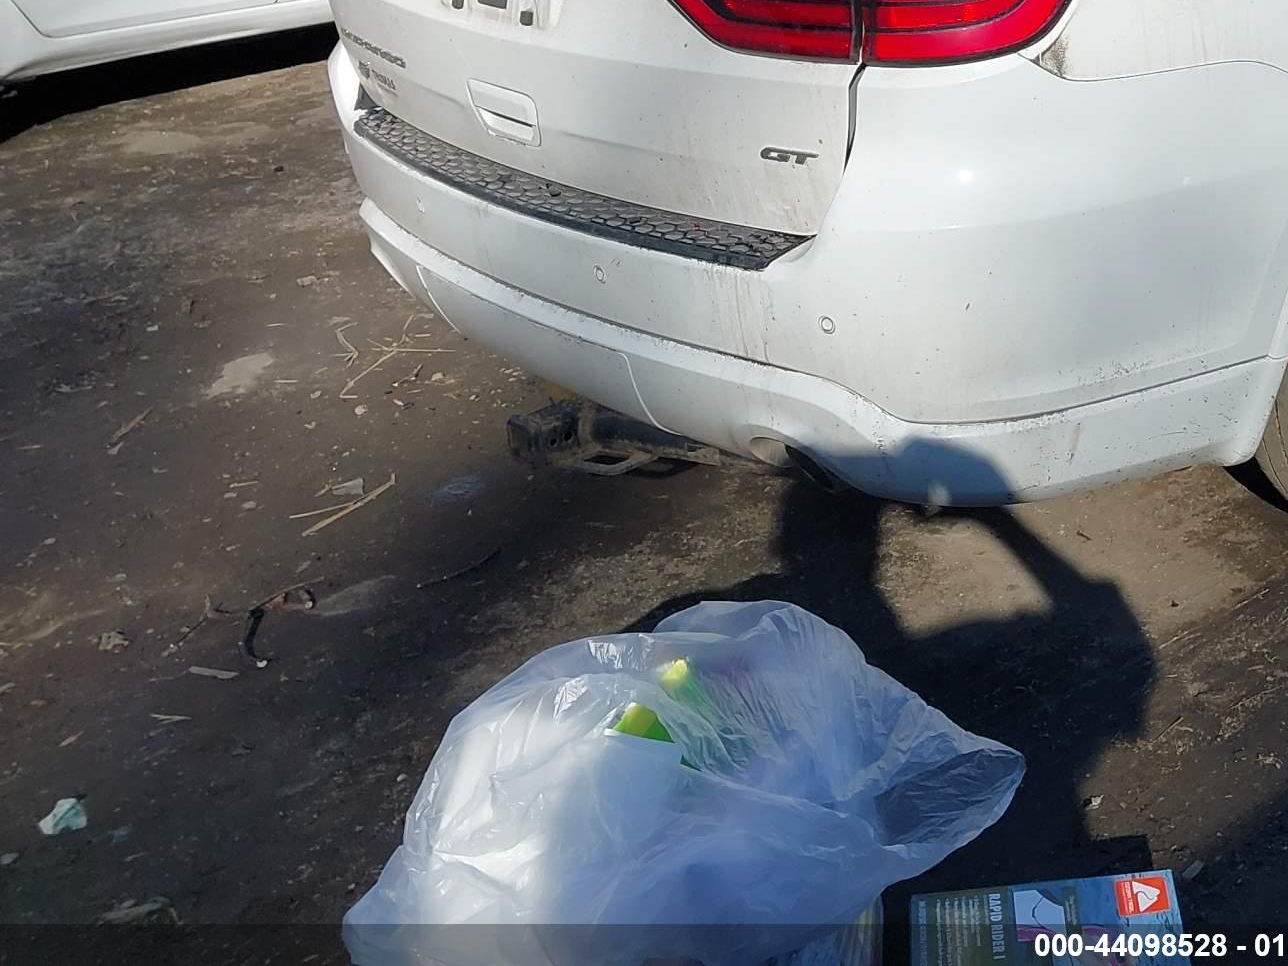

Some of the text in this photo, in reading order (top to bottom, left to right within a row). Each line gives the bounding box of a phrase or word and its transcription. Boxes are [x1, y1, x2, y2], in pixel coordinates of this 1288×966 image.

[760, 146, 820, 166] GT
[988, 893, 1002, 922] RAPID
[991, 924, 1005, 953] RIDER
